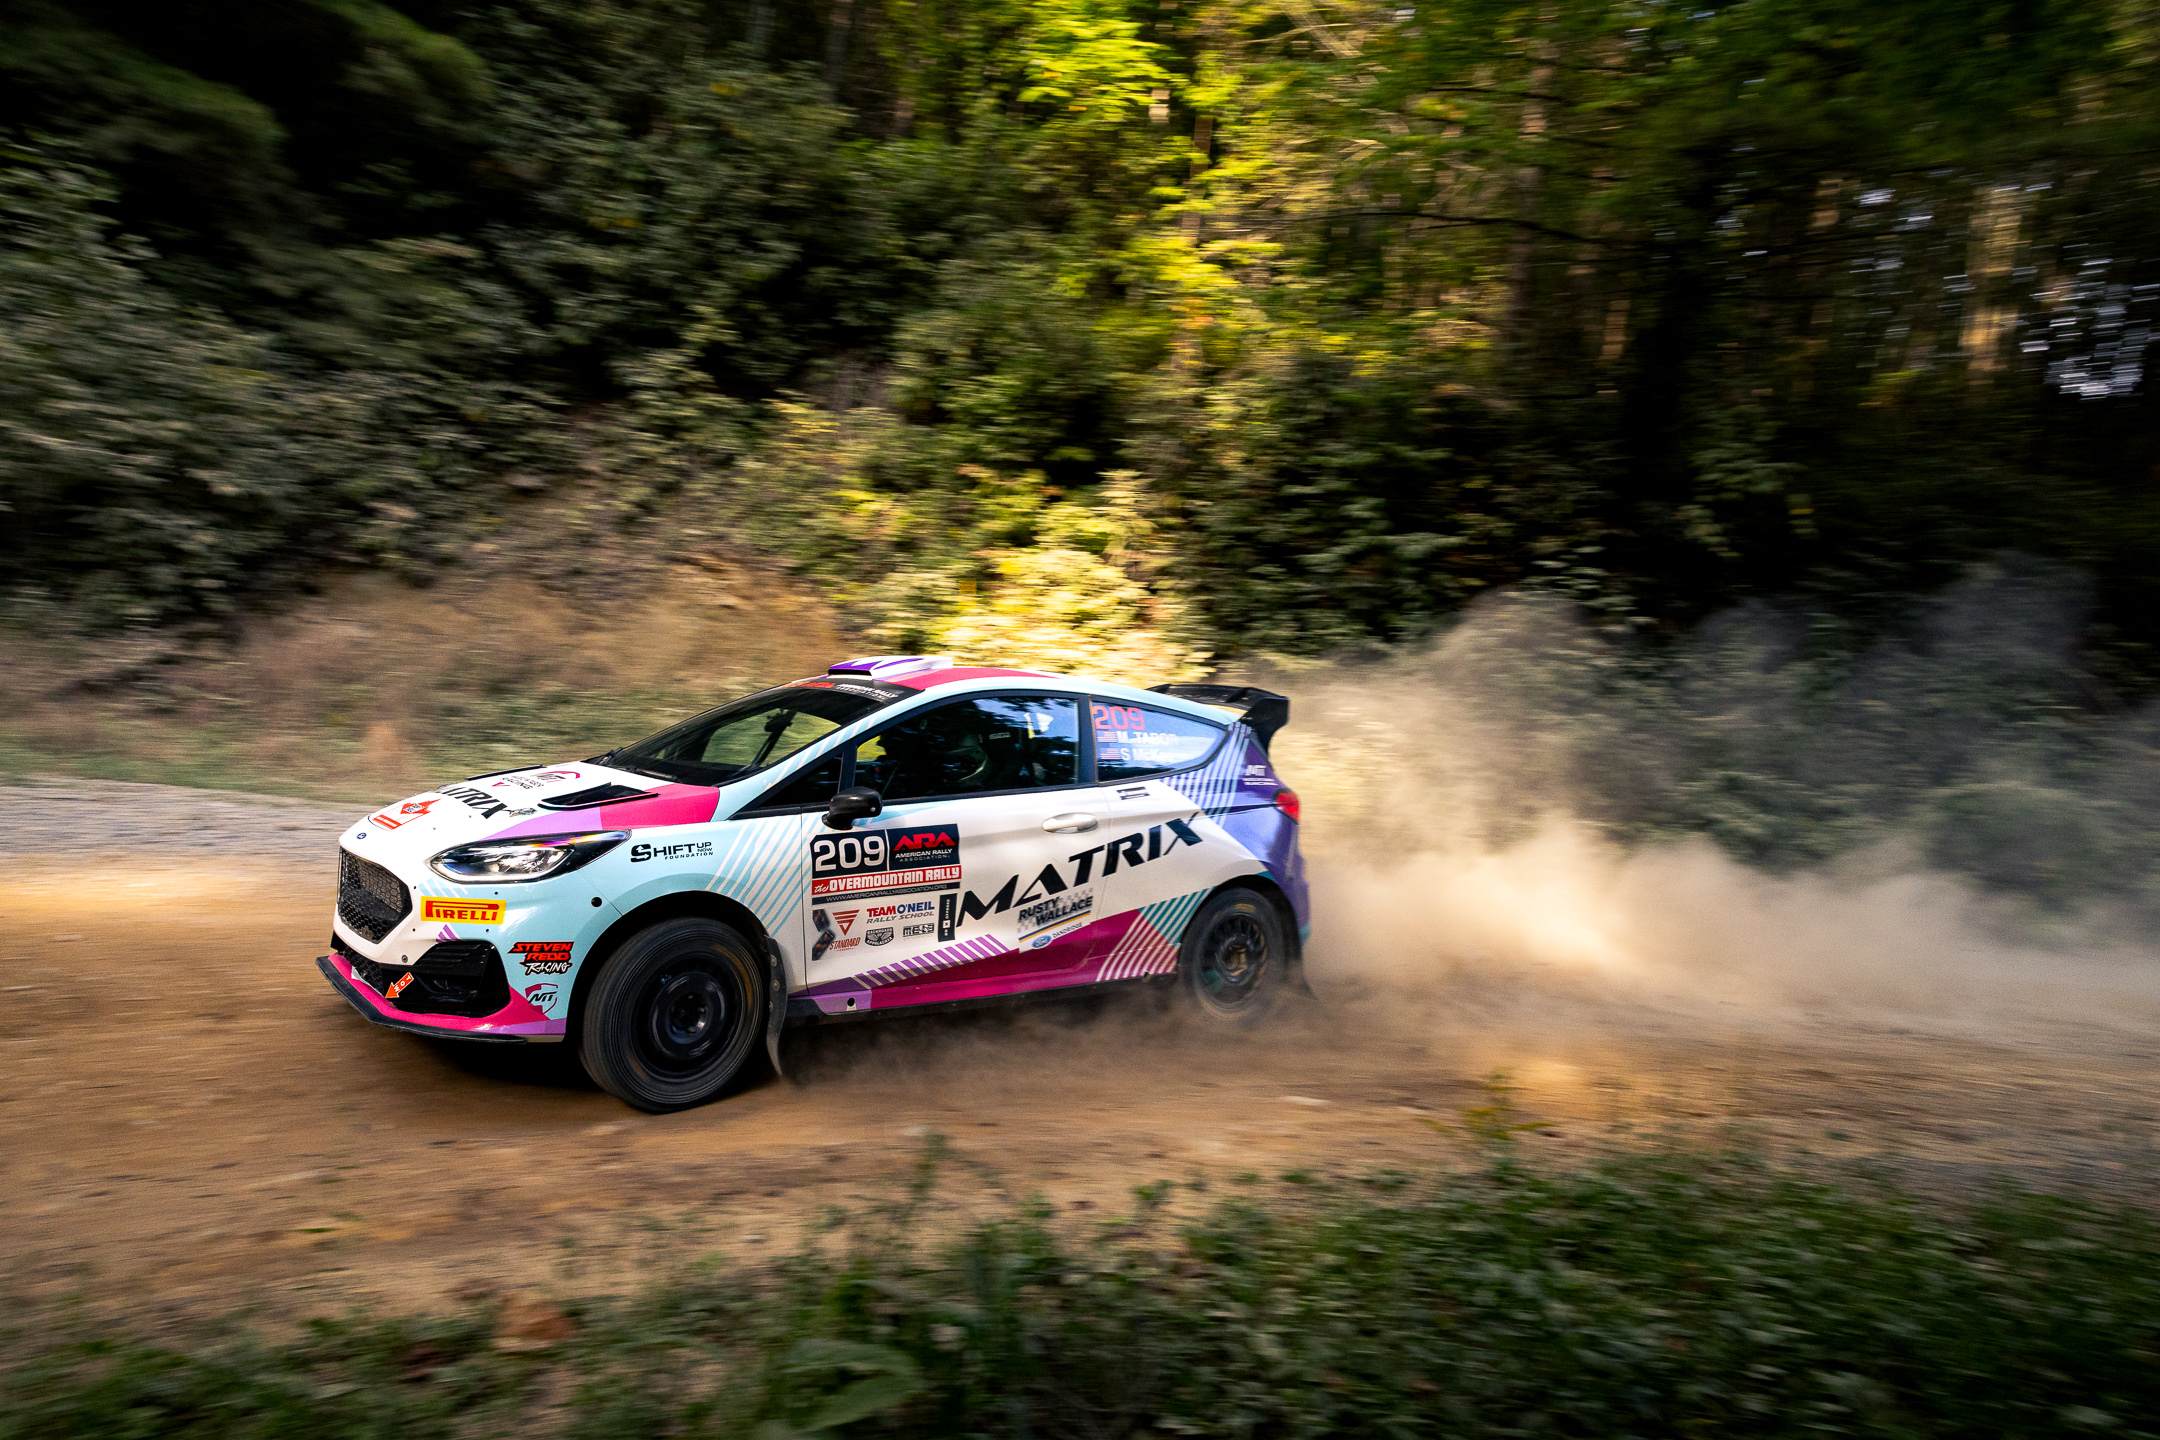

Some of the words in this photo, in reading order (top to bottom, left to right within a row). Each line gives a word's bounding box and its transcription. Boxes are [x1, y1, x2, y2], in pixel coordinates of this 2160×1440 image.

[1092, 705, 1145, 730] 209
[1120, 748, 1131, 761] S
[893, 832, 956, 851] ARA
[630, 843, 695, 863] SHIFT
[696, 841, 712, 849] UP
[664, 851, 714, 861] FOUNDATION
[813, 835, 885, 872] 209
[895, 850, 931, 859] AMERICAN
[932, 848, 953, 856] RALLY
[955, 812, 1203, 927] MATRIX
[829, 870, 924, 892] OVERMOUNTAIN
[925, 866, 960, 882] RALLY
[425, 900, 500, 921] PIRELLI
[866, 905, 897, 918] TEAM
[897, 901, 936, 914] O'NEIL
[866, 915, 897, 924] RALLY
[898, 911, 935, 921] SCHOOL
[1018, 896, 1060, 923] RUSTY
[1036, 896, 1093, 926] WALLACE
[511, 943, 573, 952] STEVEN
[526, 952, 570, 961] REDD
[525, 962, 570, 974] RACING
[393, 974, 412, 992] TOW
